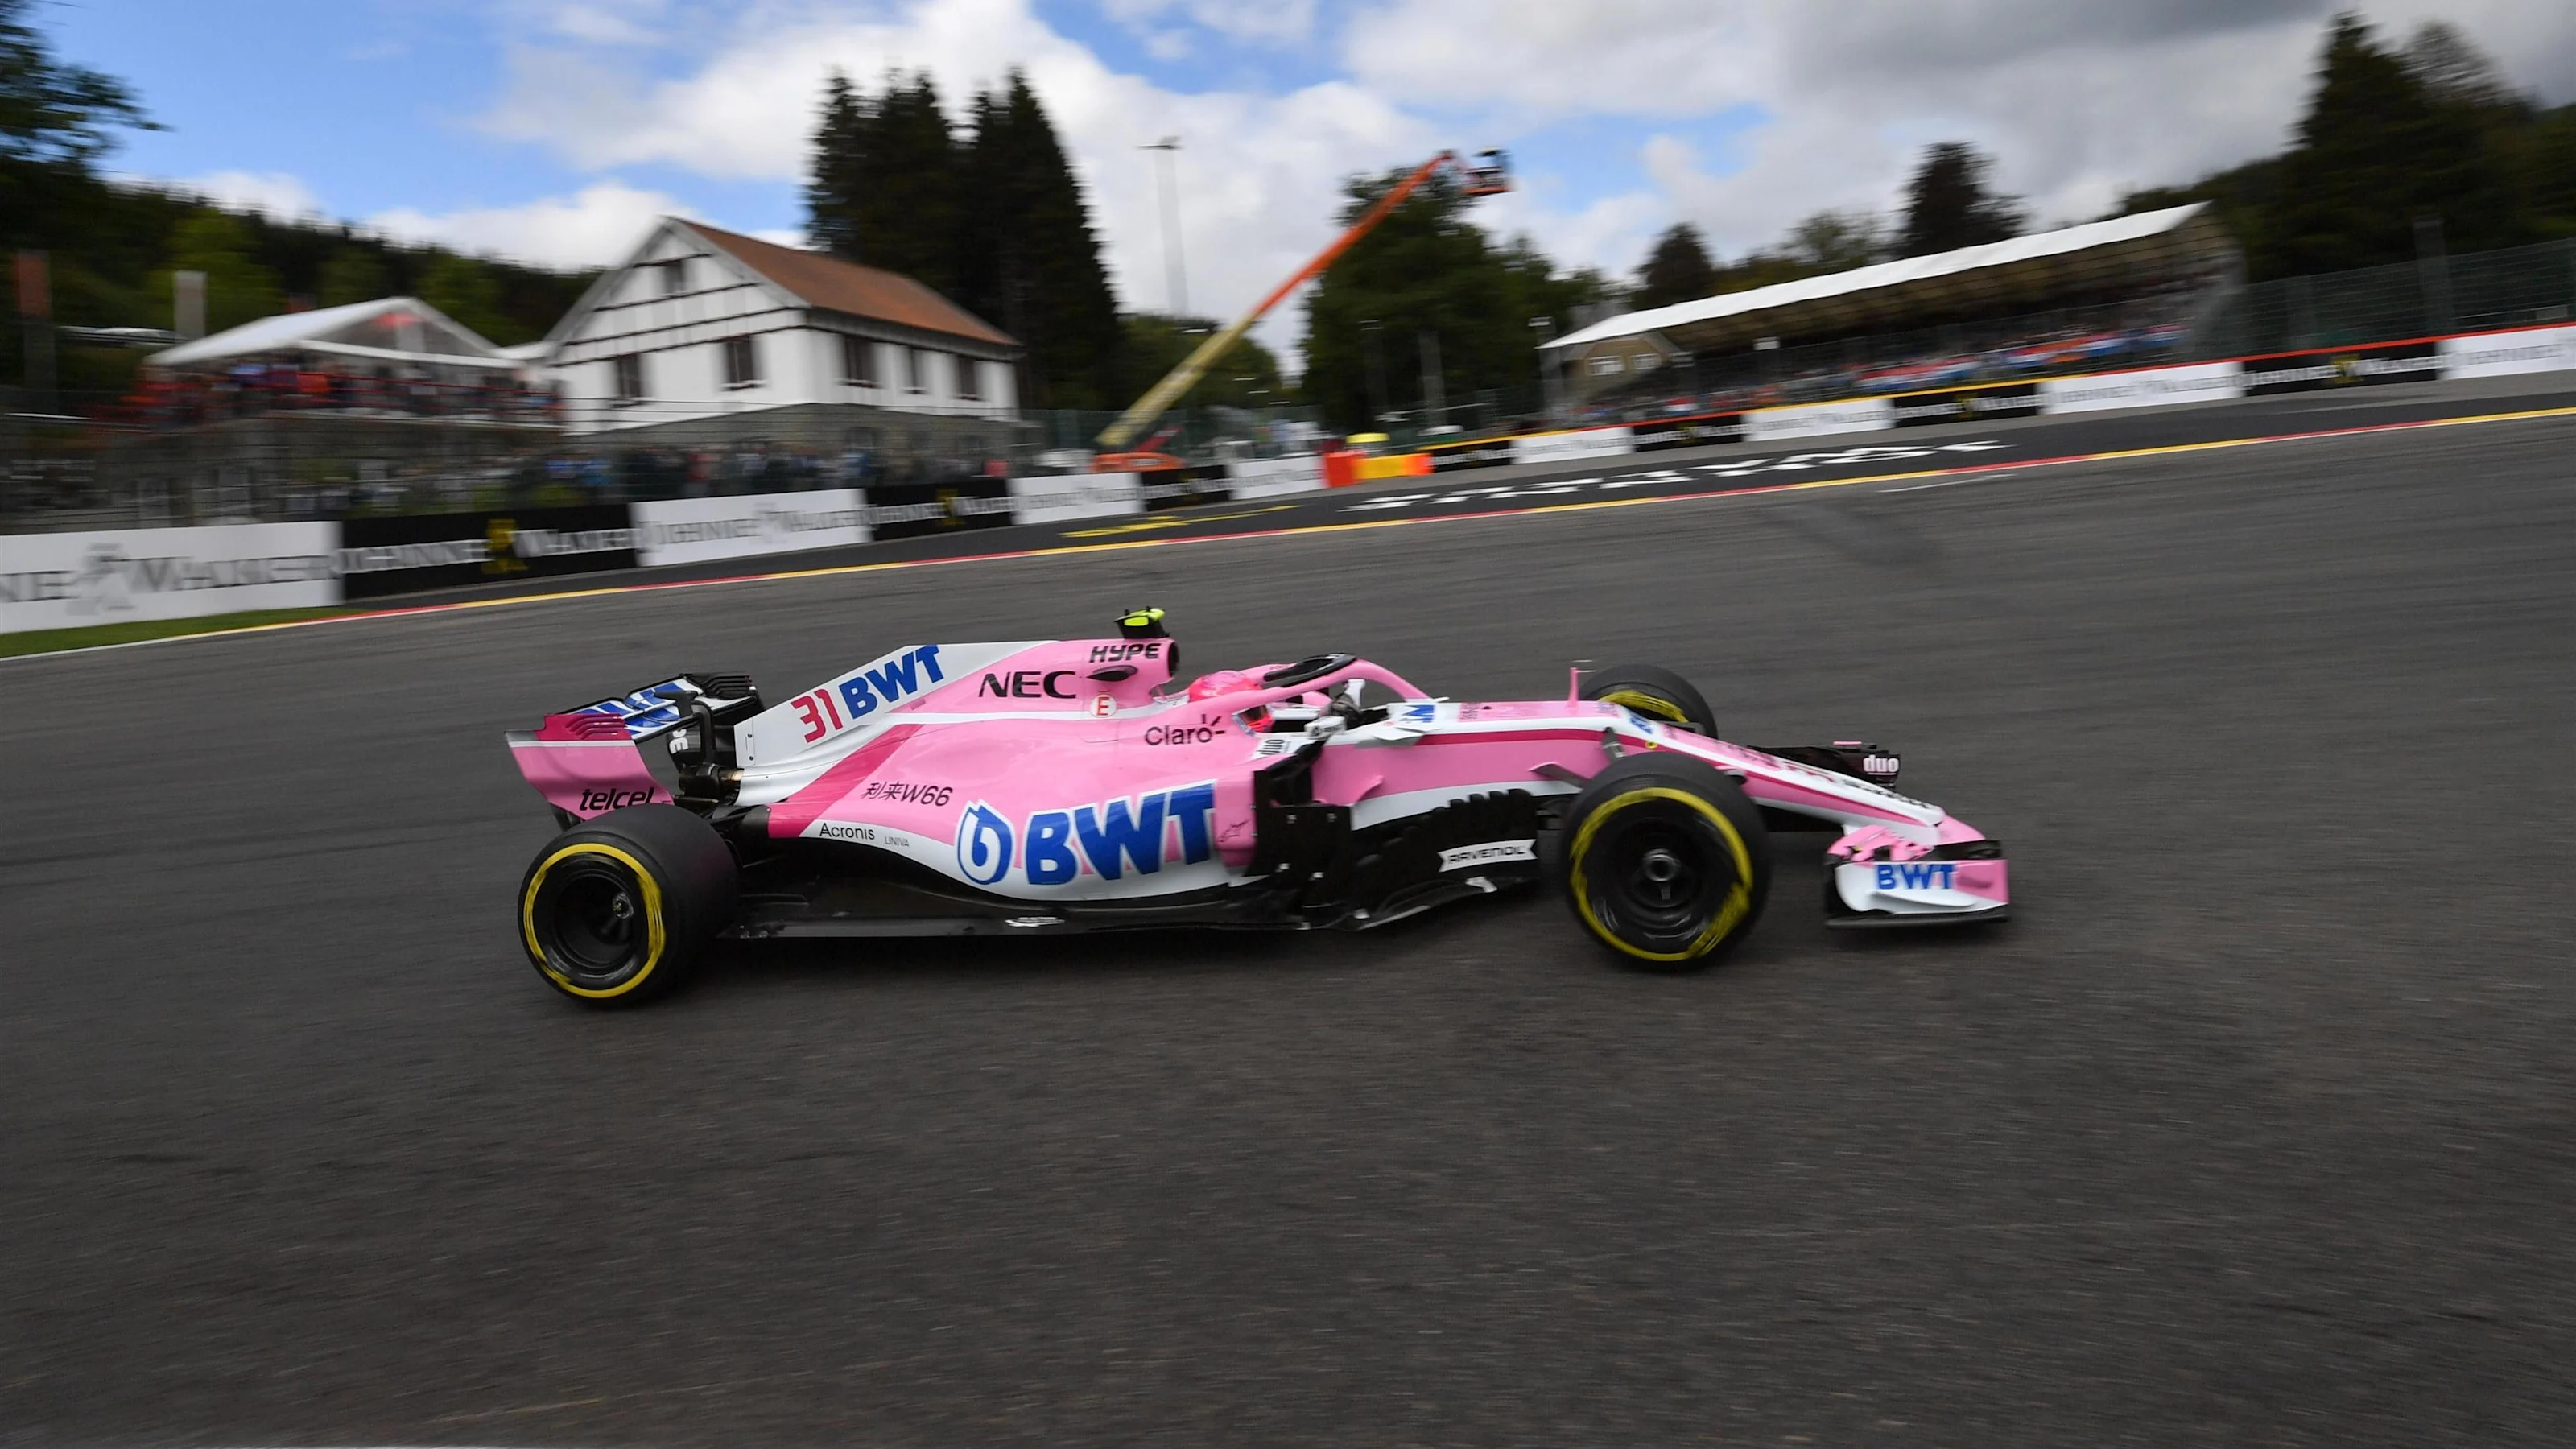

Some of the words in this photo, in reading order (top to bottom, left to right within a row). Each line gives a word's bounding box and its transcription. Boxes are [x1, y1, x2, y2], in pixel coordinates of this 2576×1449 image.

[1089, 643, 1161, 663] HYPE
[791, 688, 844, 743] 31
[839, 644, 944, 720] BWT
[979, 671, 1076, 699] NEC
[1145, 720, 1217, 745] Claro
[1863, 754, 1900, 773] duo
[580, 787, 654, 811] telcel
[819, 823, 875, 840] Acronis
[1025, 782, 1216, 886] BWT
[1877, 864, 1955, 890] BWT
